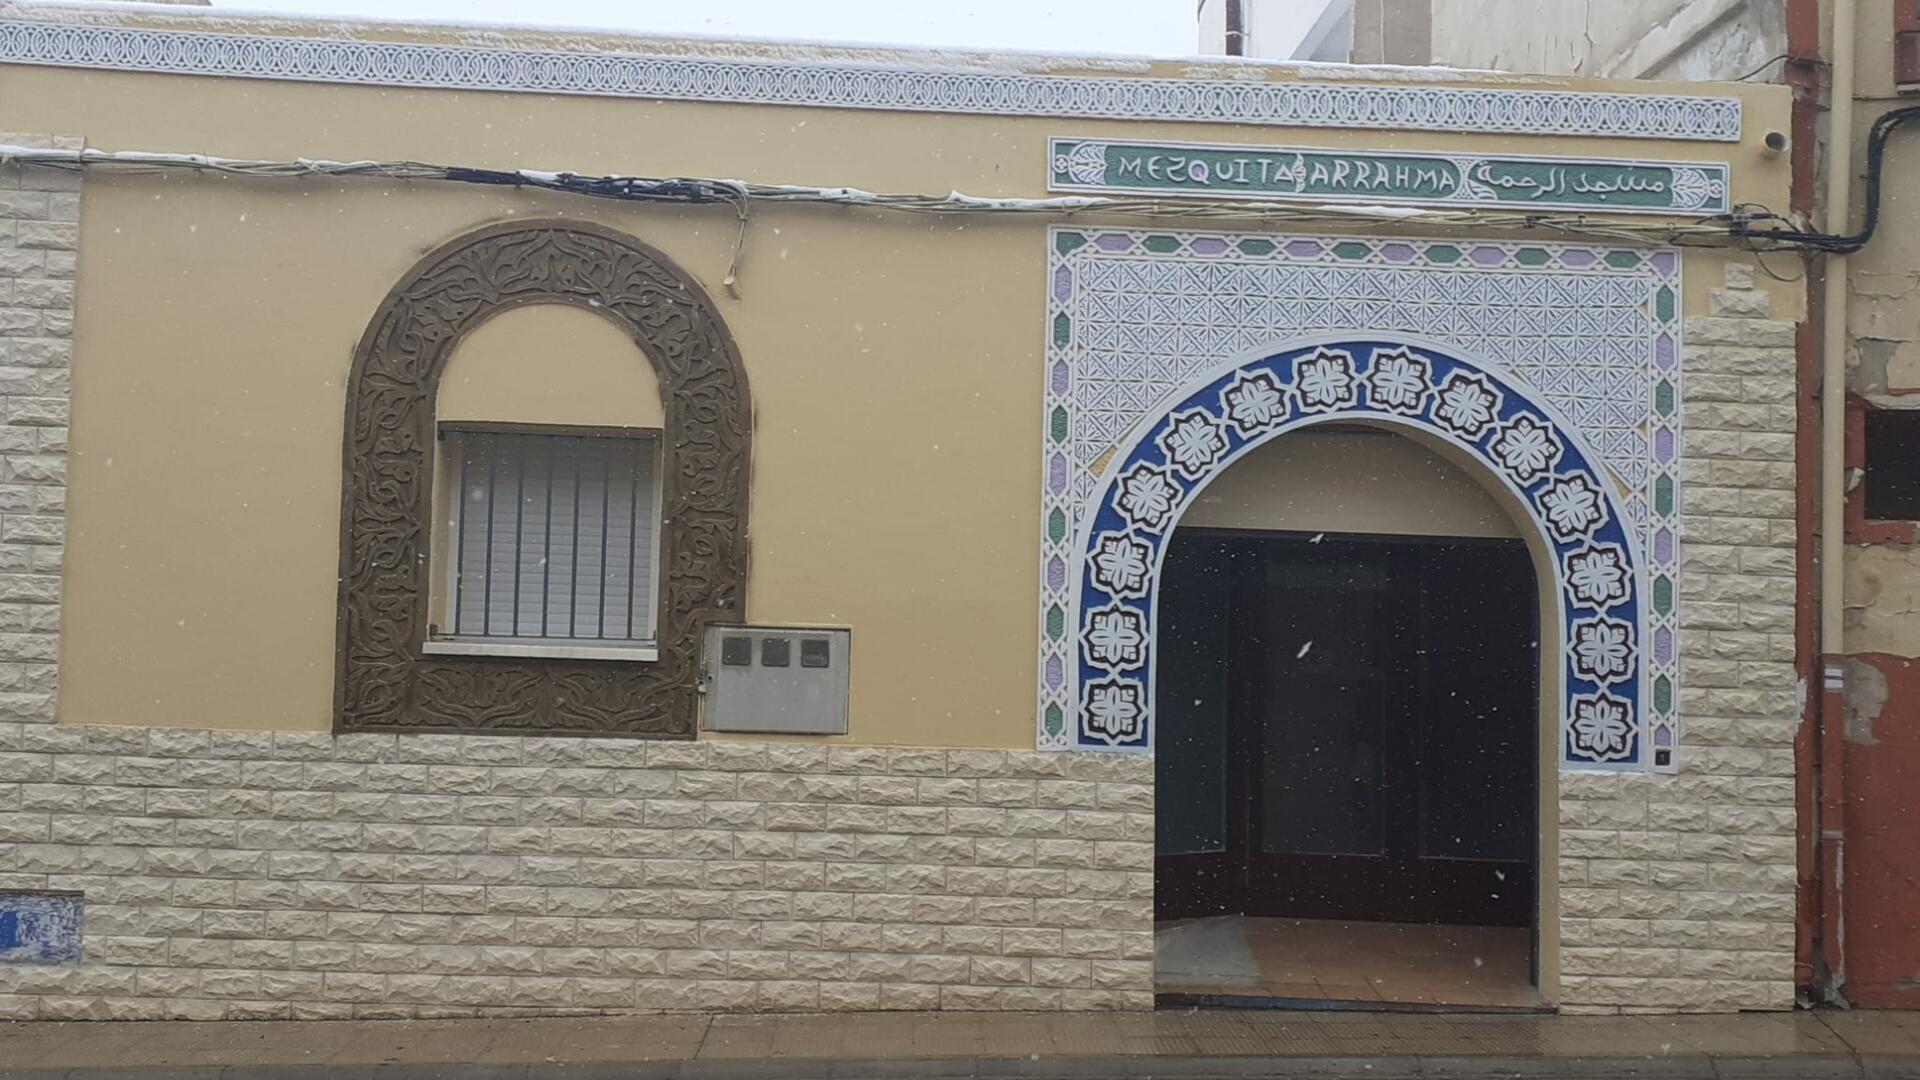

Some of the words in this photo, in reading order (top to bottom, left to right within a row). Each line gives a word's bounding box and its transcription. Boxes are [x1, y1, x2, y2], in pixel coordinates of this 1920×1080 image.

[1118, 156, 1295, 185] MEZQUITA
[1310, 159, 1455, 191] ARRAHMA
[1477, 160, 1566, 198] الرحمة
[1572, 172, 1665, 200] مسجد
